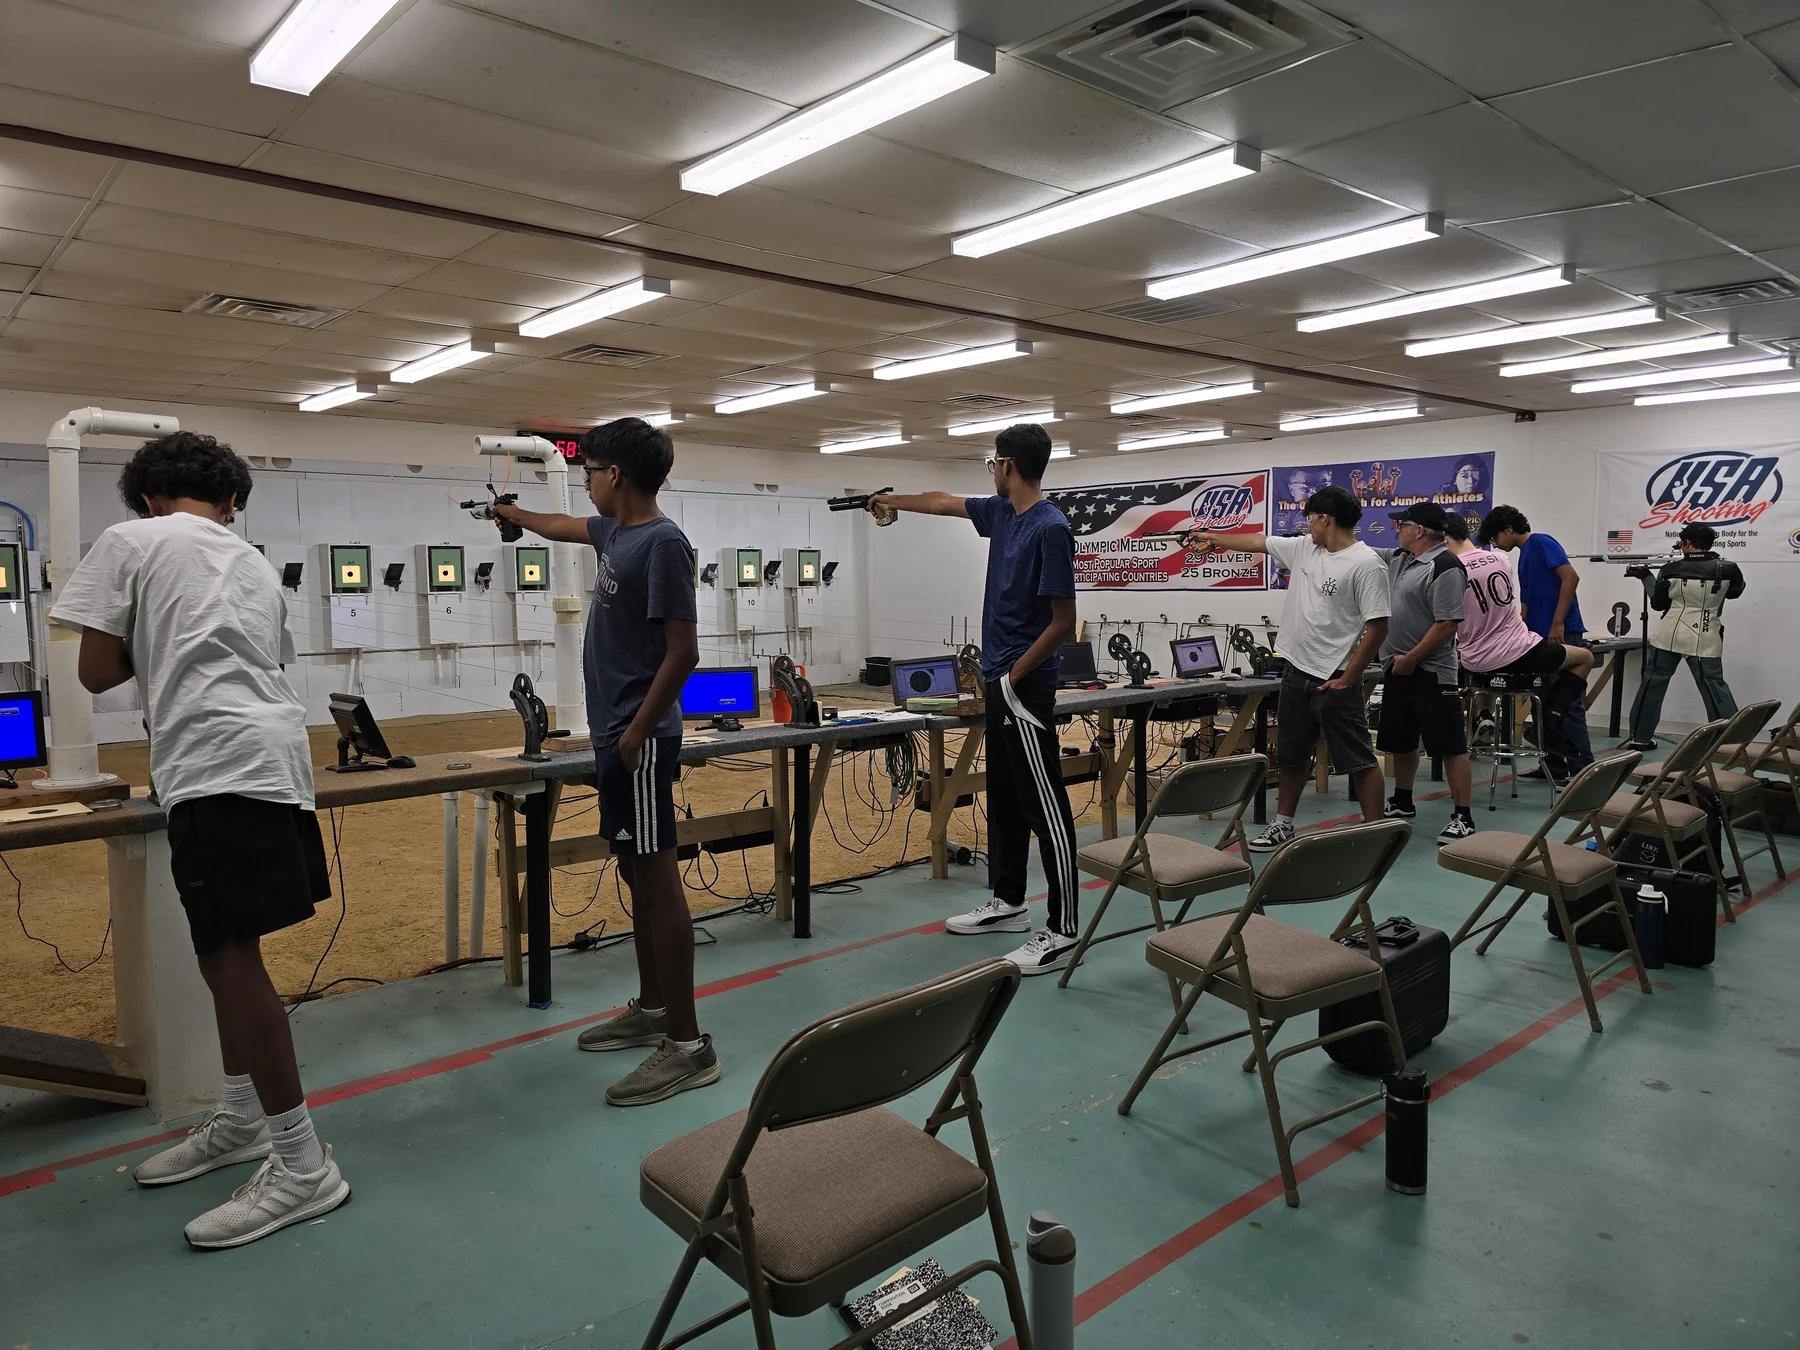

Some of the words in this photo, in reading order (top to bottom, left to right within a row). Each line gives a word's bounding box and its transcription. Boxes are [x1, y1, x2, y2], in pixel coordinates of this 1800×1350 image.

[1653, 456, 1780, 511] USA
[1195, 488, 1252, 519] USA
[1278, 500, 1297, 510] The
[1371, 497, 1388, 507] for
[1432, 492, 1484, 505] Athletes
[1638, 498, 1769, 529] Shooting
[1188, 513, 1247, 530] Shooting
[1721, 530, 1737, 539] Body
[1120, 538, 1168, 552] MEDALS
[1727, 540, 1746, 548] Sports
[1094, 558, 1131, 570] POPULAR
[1131, 556, 1159, 569] SPORT
[1186, 553, 1203, 563] 29
[1207, 553, 1253, 563] SILVER
[1464, 554, 1499, 570] MESSI
[1075, 572, 1120, 582] RTICIPATING
[1121, 570, 1169, 582] COUNTRIES
[1181, 567, 1199, 578] 25
[1203, 567, 1258, 578] BRONZE
[1466, 570, 1514, 615] 10
[350, 609, 357, 618] 5
[446, 606, 452, 614] 6
[532, 604, 538, 612] 7
[1641, 841, 1659, 853] LINK
